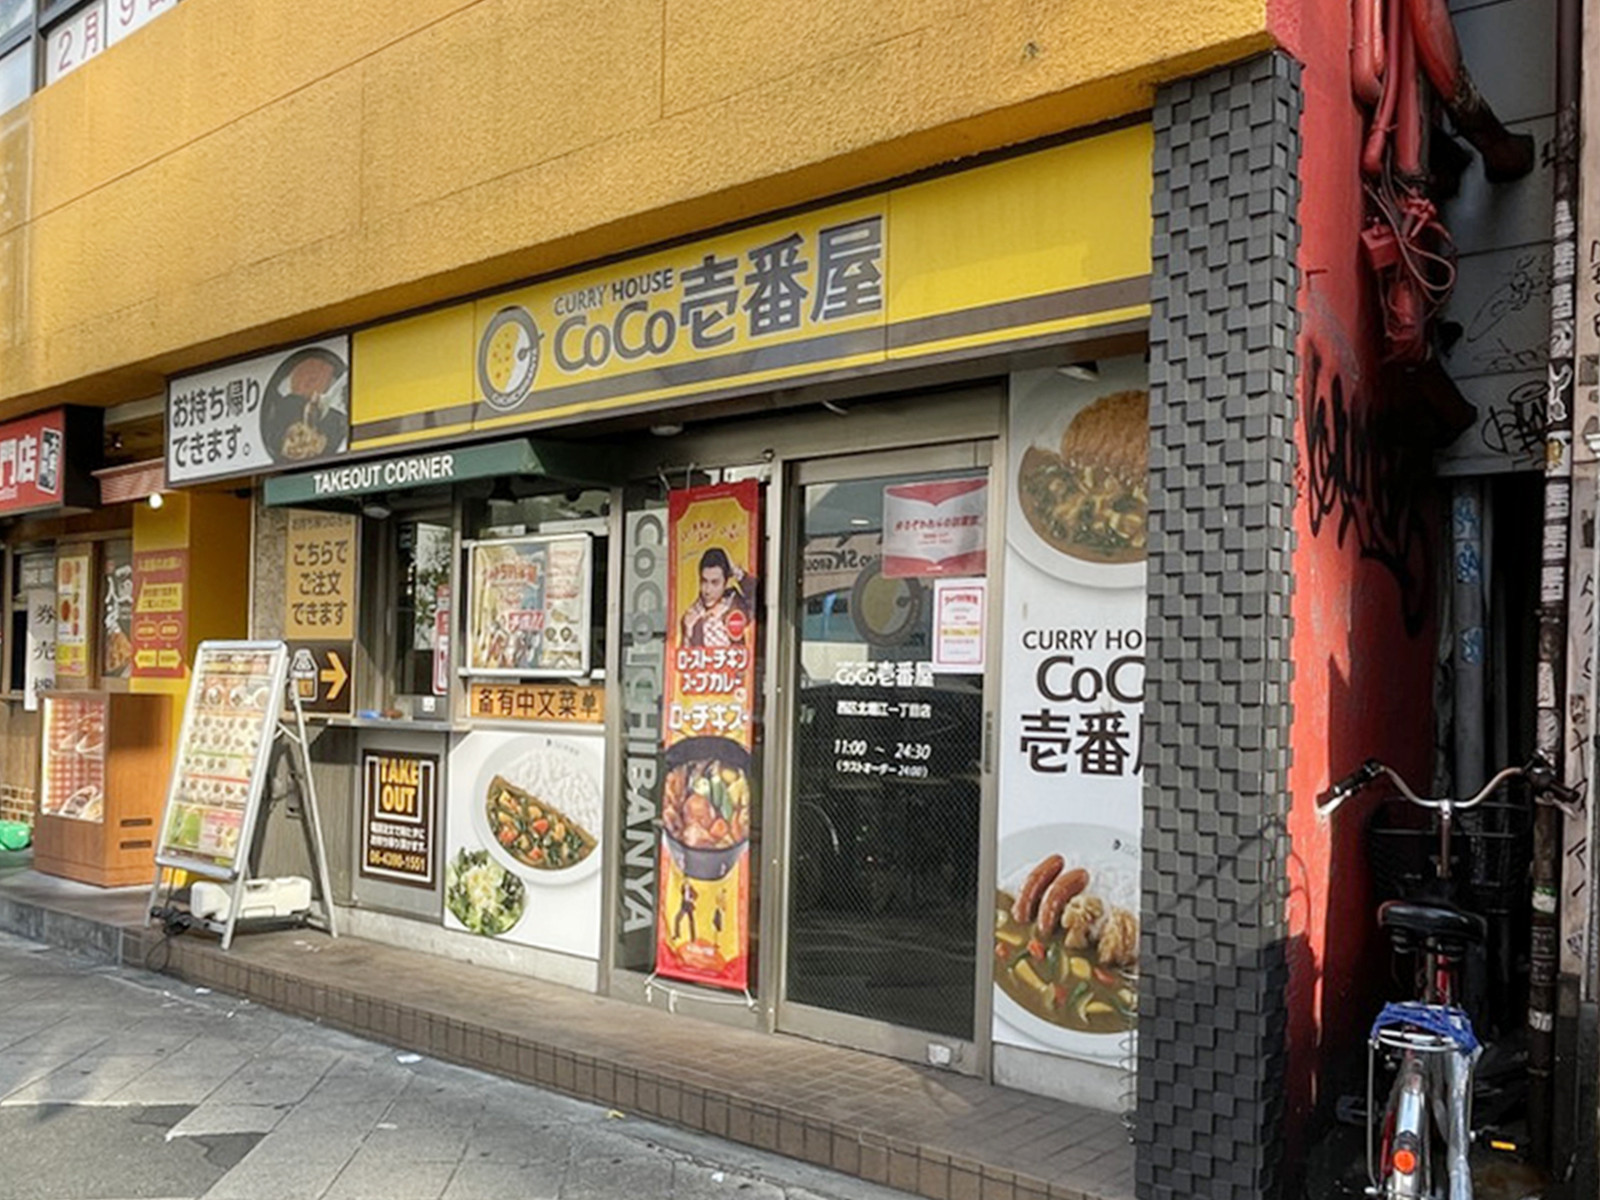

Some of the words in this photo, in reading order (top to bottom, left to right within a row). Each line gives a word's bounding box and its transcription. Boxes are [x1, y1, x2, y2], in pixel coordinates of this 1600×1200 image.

[553, 284, 606, 316] CURRY
[611, 268, 673, 302] HOUSE
[172, 378, 260, 428] お持ち帰り
[172, 425, 252, 468] できます。
[313, 465, 381, 494] TAKEOUT
[384, 455, 454, 487] CORNER
[293, 540, 348, 566] こちらで
[299, 570, 342, 596] ご注文
[291, 600, 348, 626] できます
[1022, 629, 1098, 650] CURRY
[380, 756, 420, 786] TAKE
[382, 786, 416, 813] OUT
